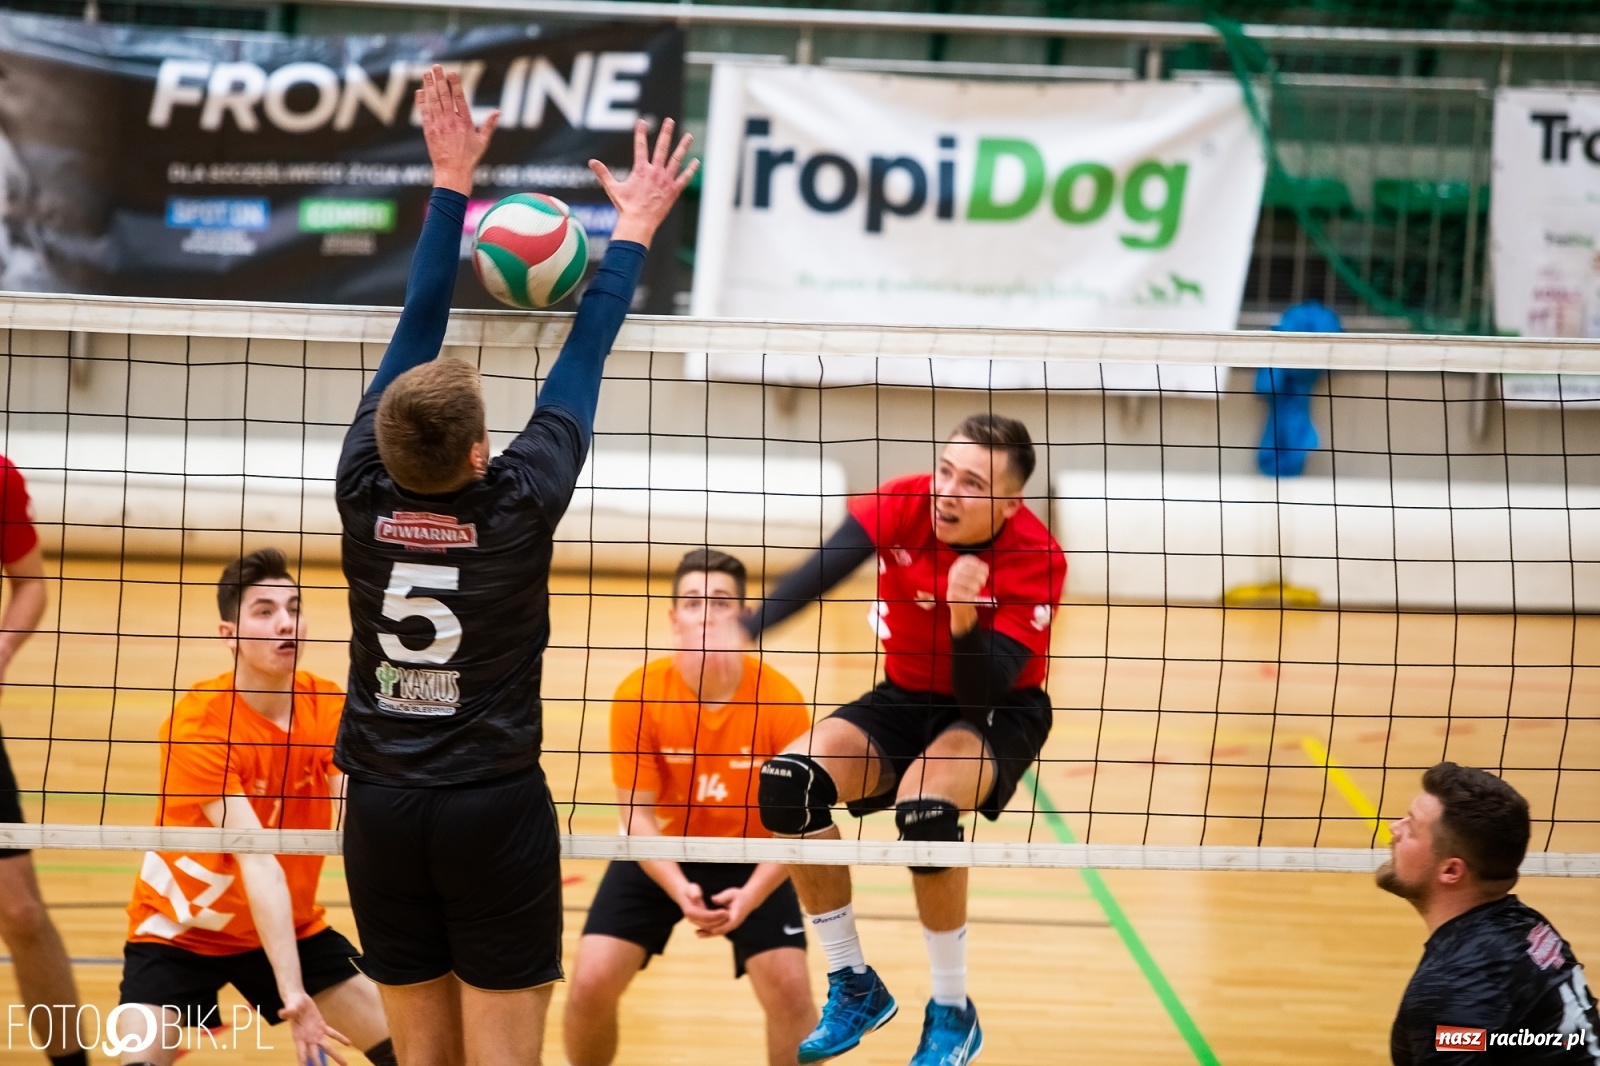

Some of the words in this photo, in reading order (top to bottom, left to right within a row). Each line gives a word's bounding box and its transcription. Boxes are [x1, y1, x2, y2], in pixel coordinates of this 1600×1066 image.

[382, 523, 469, 542] PIWIARNIA
[377, 561, 463, 665] 5
[398, 667, 460, 702] KAKTUS
[697, 773, 728, 802] 14
